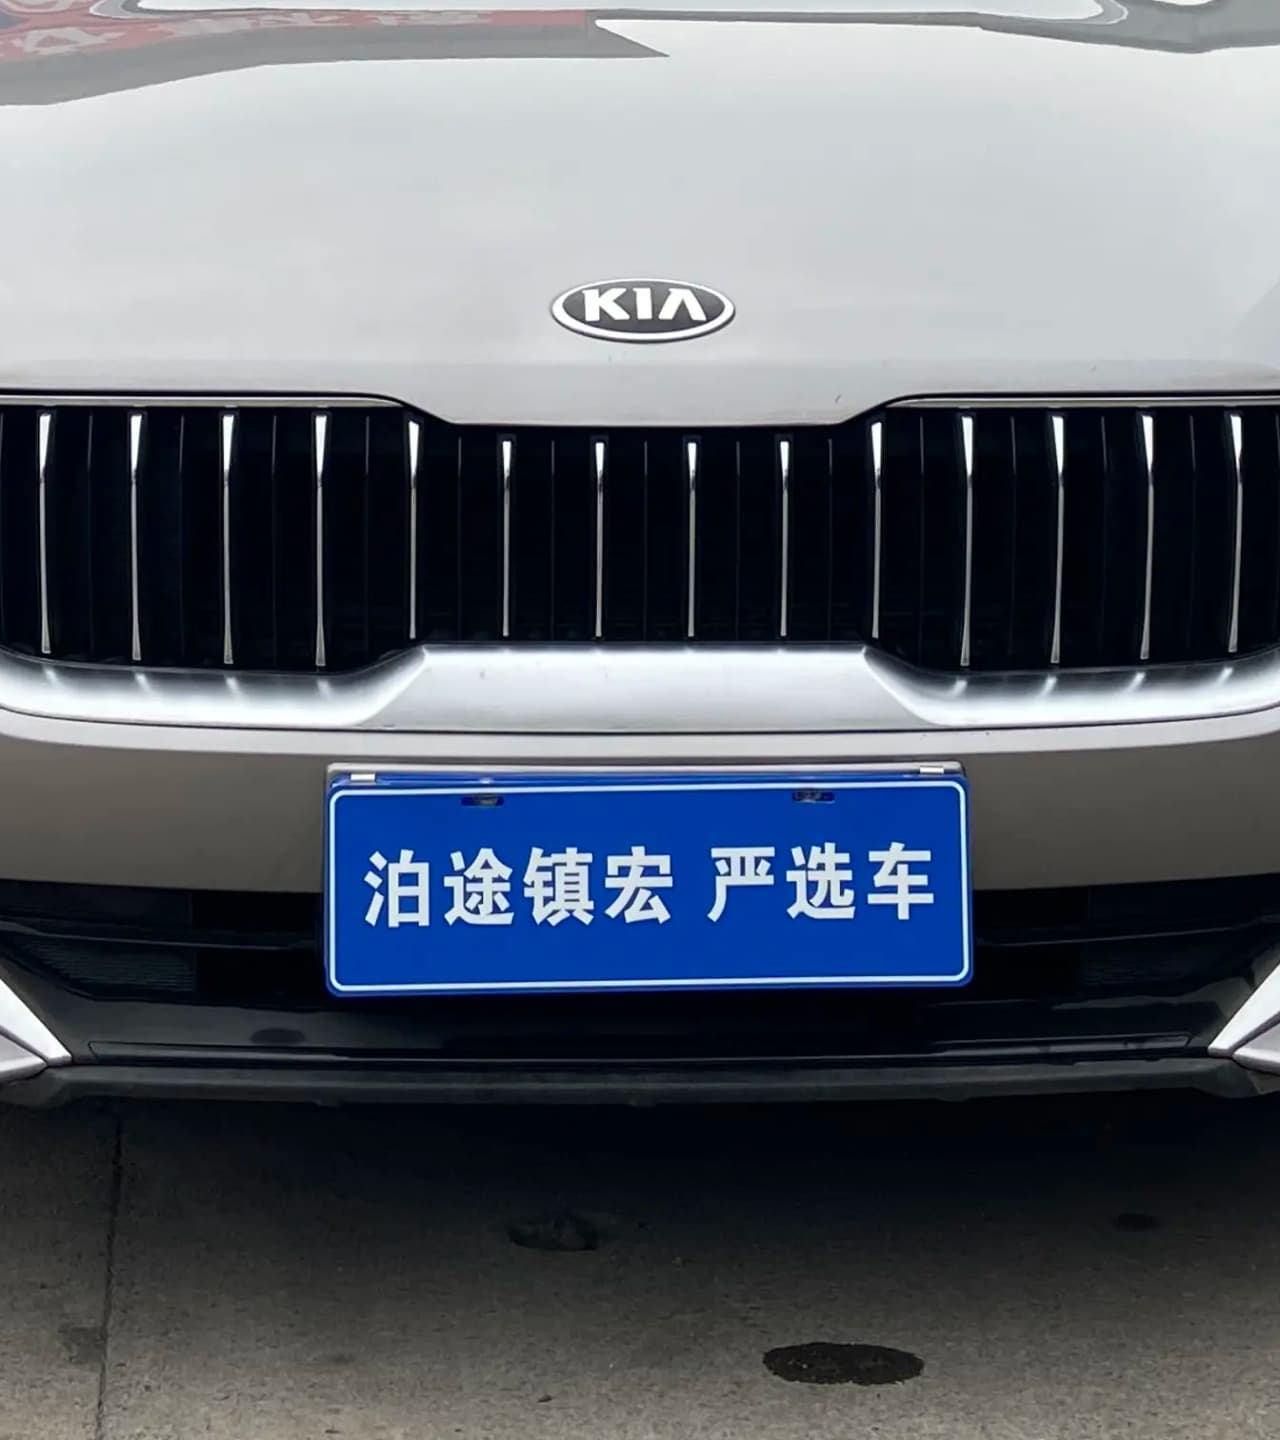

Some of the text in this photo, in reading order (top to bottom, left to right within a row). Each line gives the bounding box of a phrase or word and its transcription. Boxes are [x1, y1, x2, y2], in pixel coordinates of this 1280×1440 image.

[582, 287, 707, 322] KIA
[363, 841, 936, 928] 泊途镇宏 严选车
